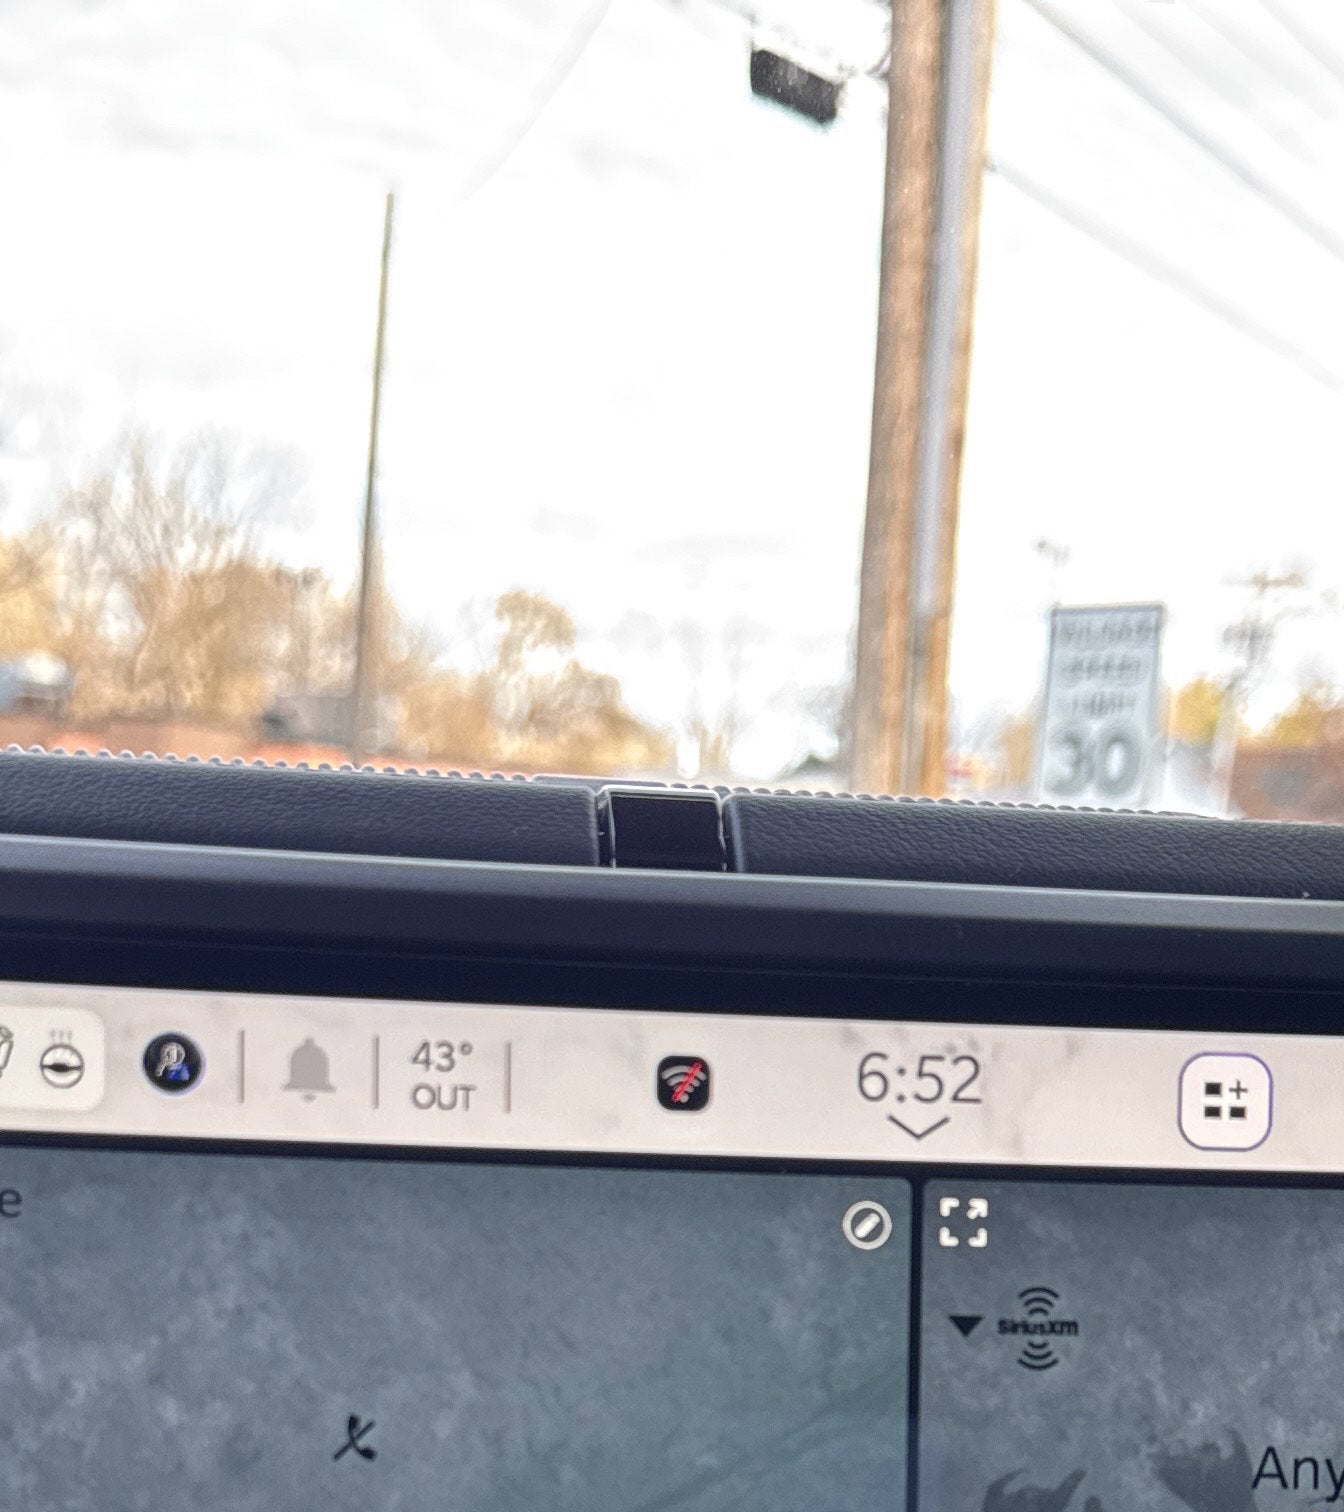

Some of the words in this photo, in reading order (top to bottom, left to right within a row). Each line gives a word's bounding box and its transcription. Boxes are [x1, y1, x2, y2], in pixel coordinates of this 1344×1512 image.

[410, 1039, 474, 1074] 43°
[856, 1051, 983, 1105] 6:52
[410, 1083, 476, 1112] OUT
